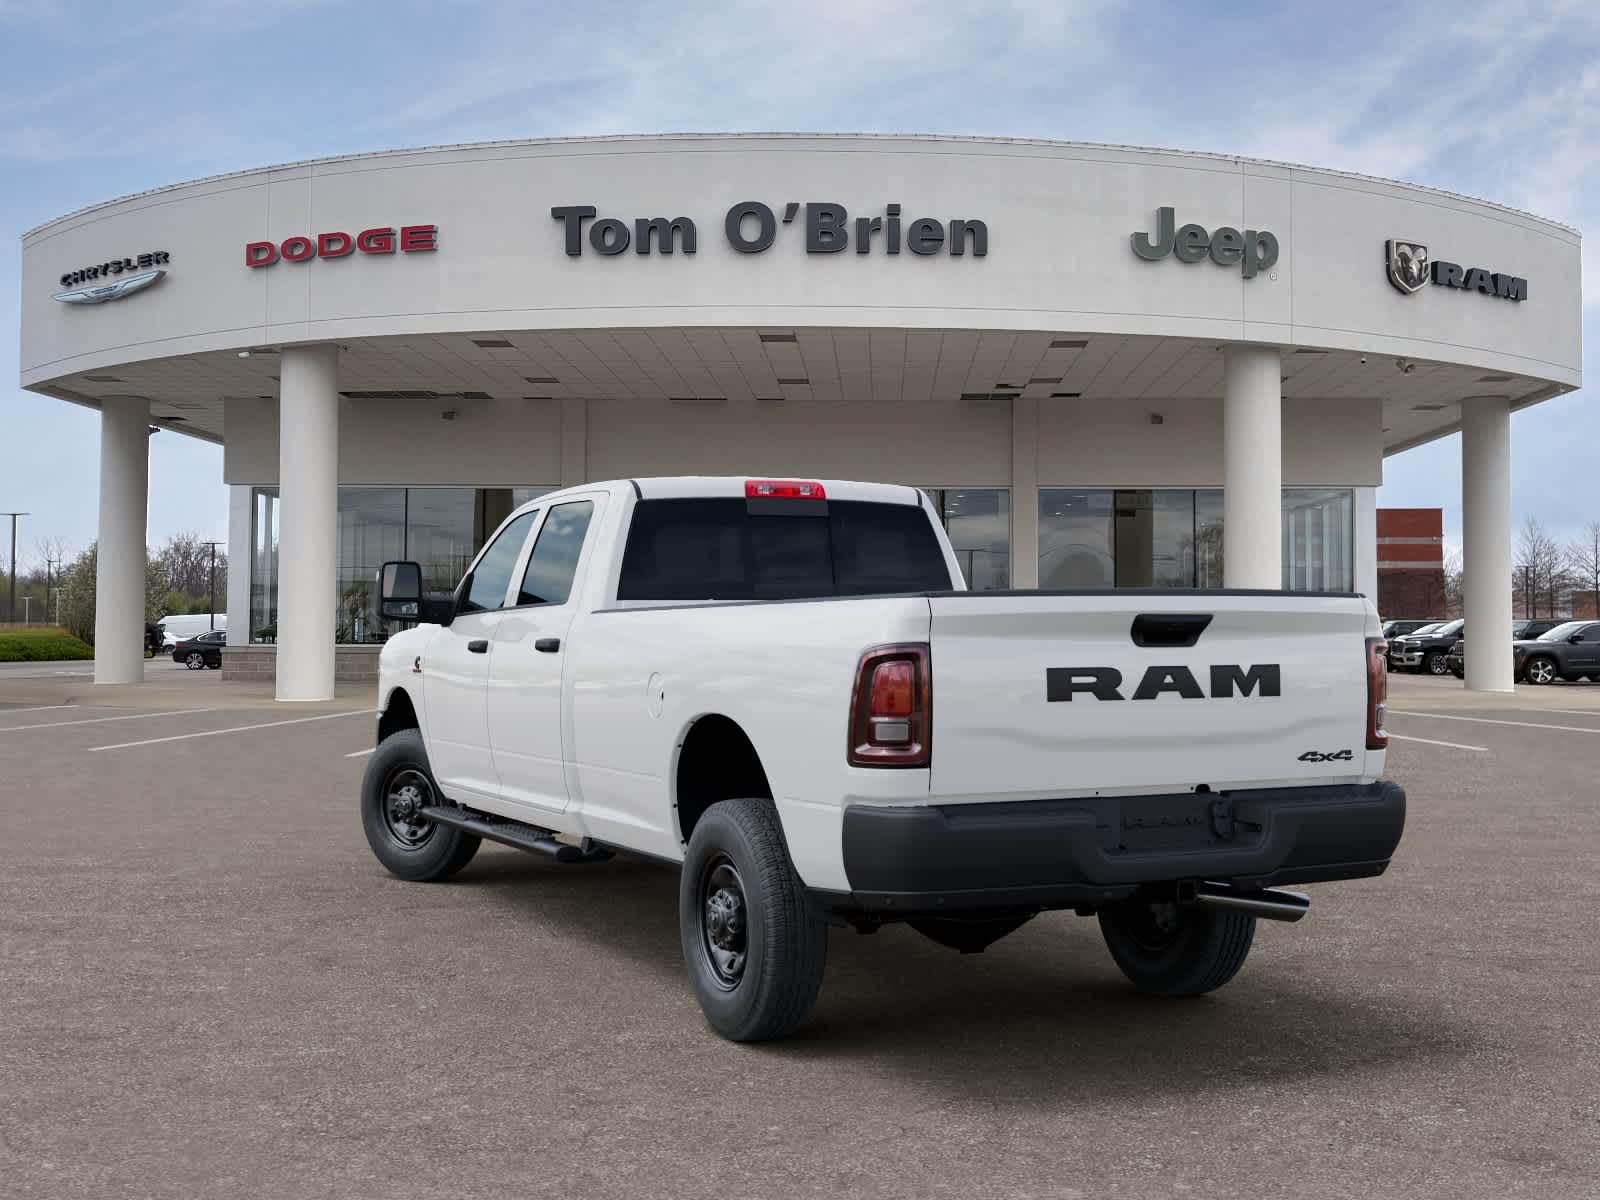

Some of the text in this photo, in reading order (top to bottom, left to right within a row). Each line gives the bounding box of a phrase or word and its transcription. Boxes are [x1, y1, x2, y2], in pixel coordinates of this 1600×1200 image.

[246, 224, 439, 268] DODGE
[551, 205, 697, 256] Tom
[1130, 206, 1280, 279] Jeep
[60, 250, 169, 286] CHRYSLER
[1430, 260, 1527, 300] RAM
[1046, 664, 1281, 702] RAM
[1297, 749, 1354, 763] 4x4
